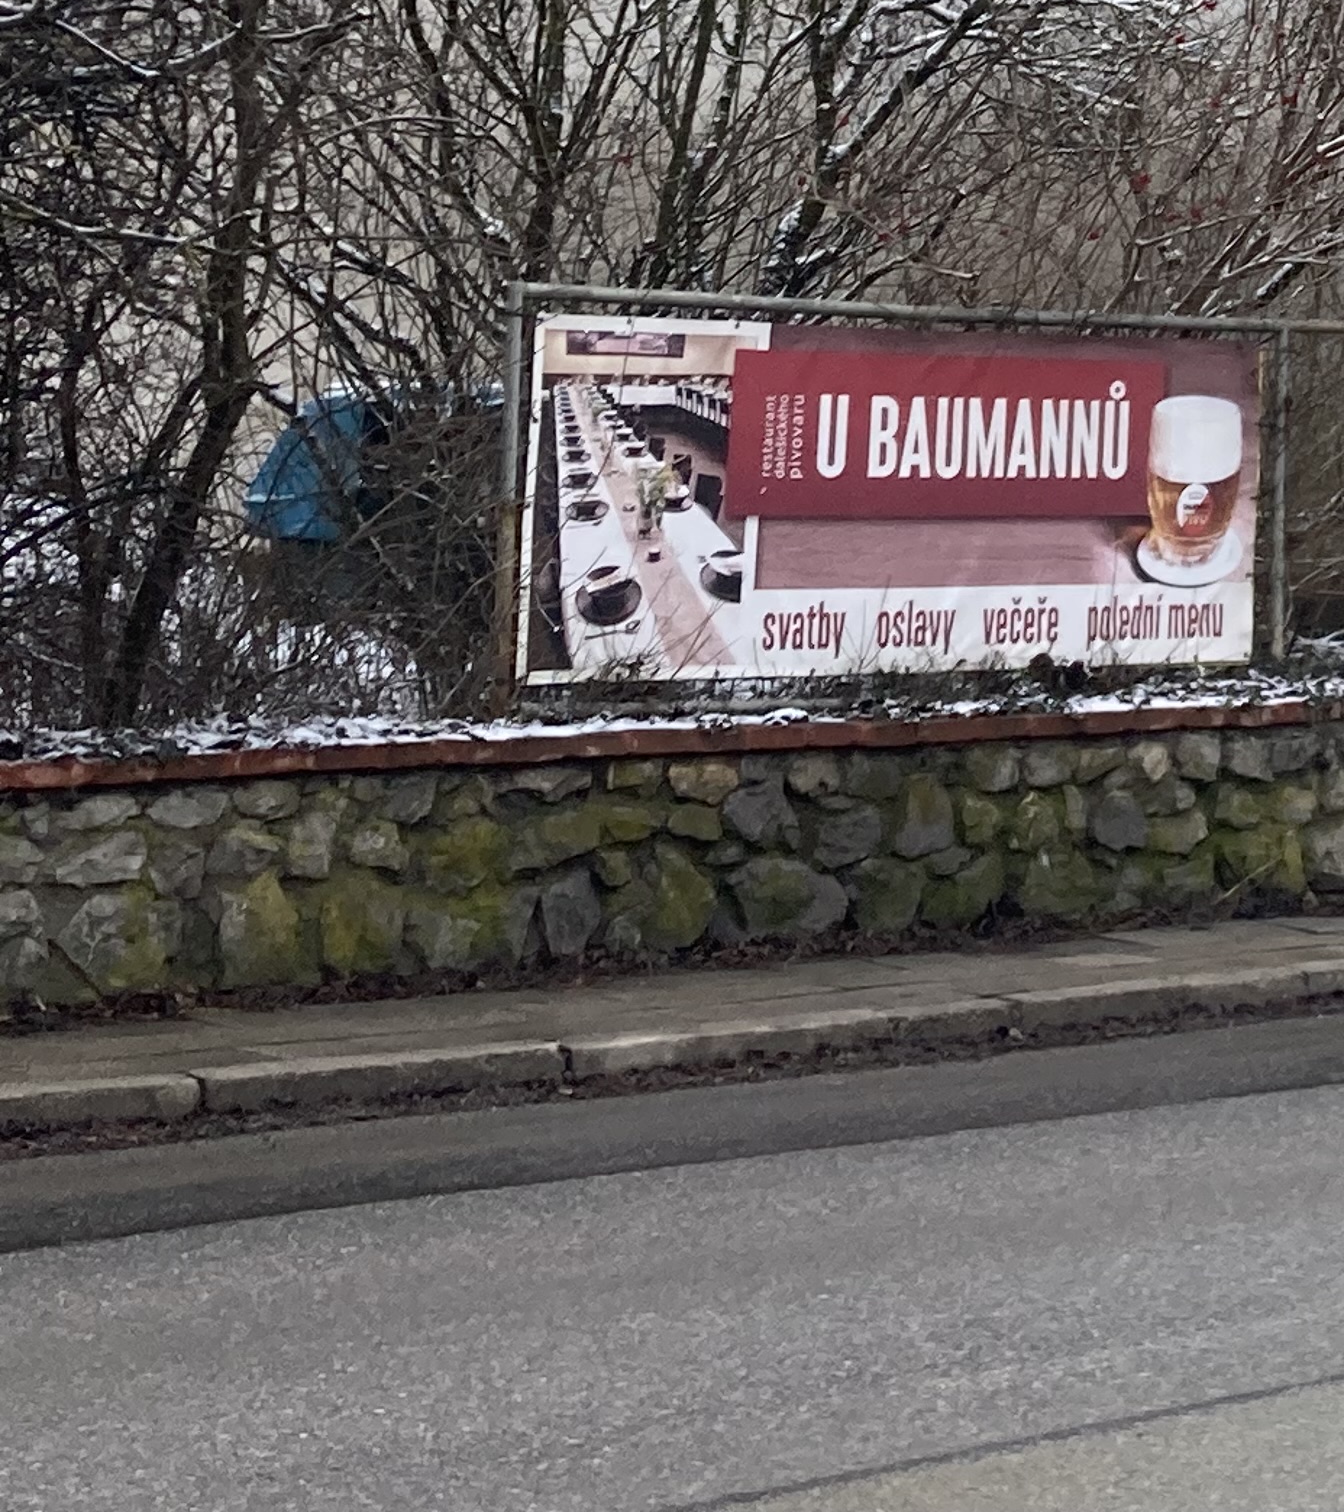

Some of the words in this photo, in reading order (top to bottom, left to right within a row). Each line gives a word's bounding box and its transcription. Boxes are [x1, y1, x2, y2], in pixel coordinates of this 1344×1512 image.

[761, 394, 777, 478] restaurant
[772, 394, 790, 479] dalešického
[789, 394, 806, 480] pivovaru
[816, 393, 850, 479] U
[866, 380, 1131, 481] BAUMANNŮ
[762, 602, 846, 659] svatby
[876, 600, 957, 655] oslavy
[983, 596, 1059, 645] večeře
[1086, 594, 1163, 652] polední
[1167, 601, 1224, 639] menu
